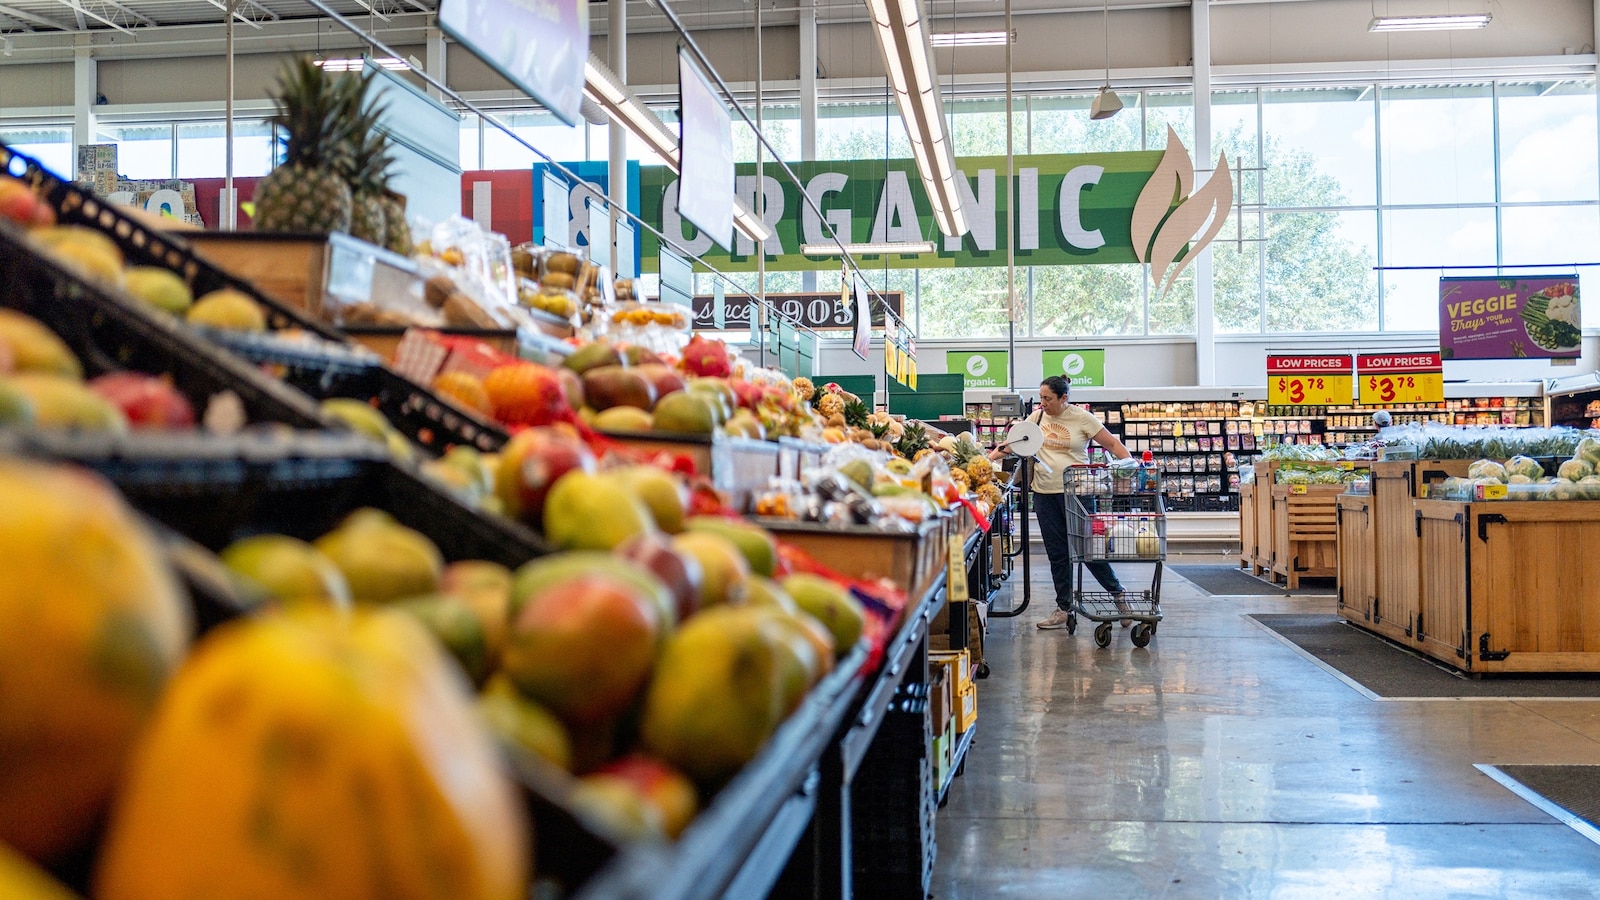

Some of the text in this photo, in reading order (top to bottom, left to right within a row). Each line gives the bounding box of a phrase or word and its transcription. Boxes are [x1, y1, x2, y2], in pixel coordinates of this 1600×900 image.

[662, 164, 1106, 257] ORGANIC
[693, 301, 751, 319] snce
[1447, 293, 1518, 319] VEGGIE
[1451, 316, 1485, 332] Trays
[1486, 314, 1503, 322] YOUR
[1499, 317, 1513, 325] WAY
[1276, 358, 1342, 368] LOW PRICES
[1366, 356, 1433, 367] LOW PRICES
